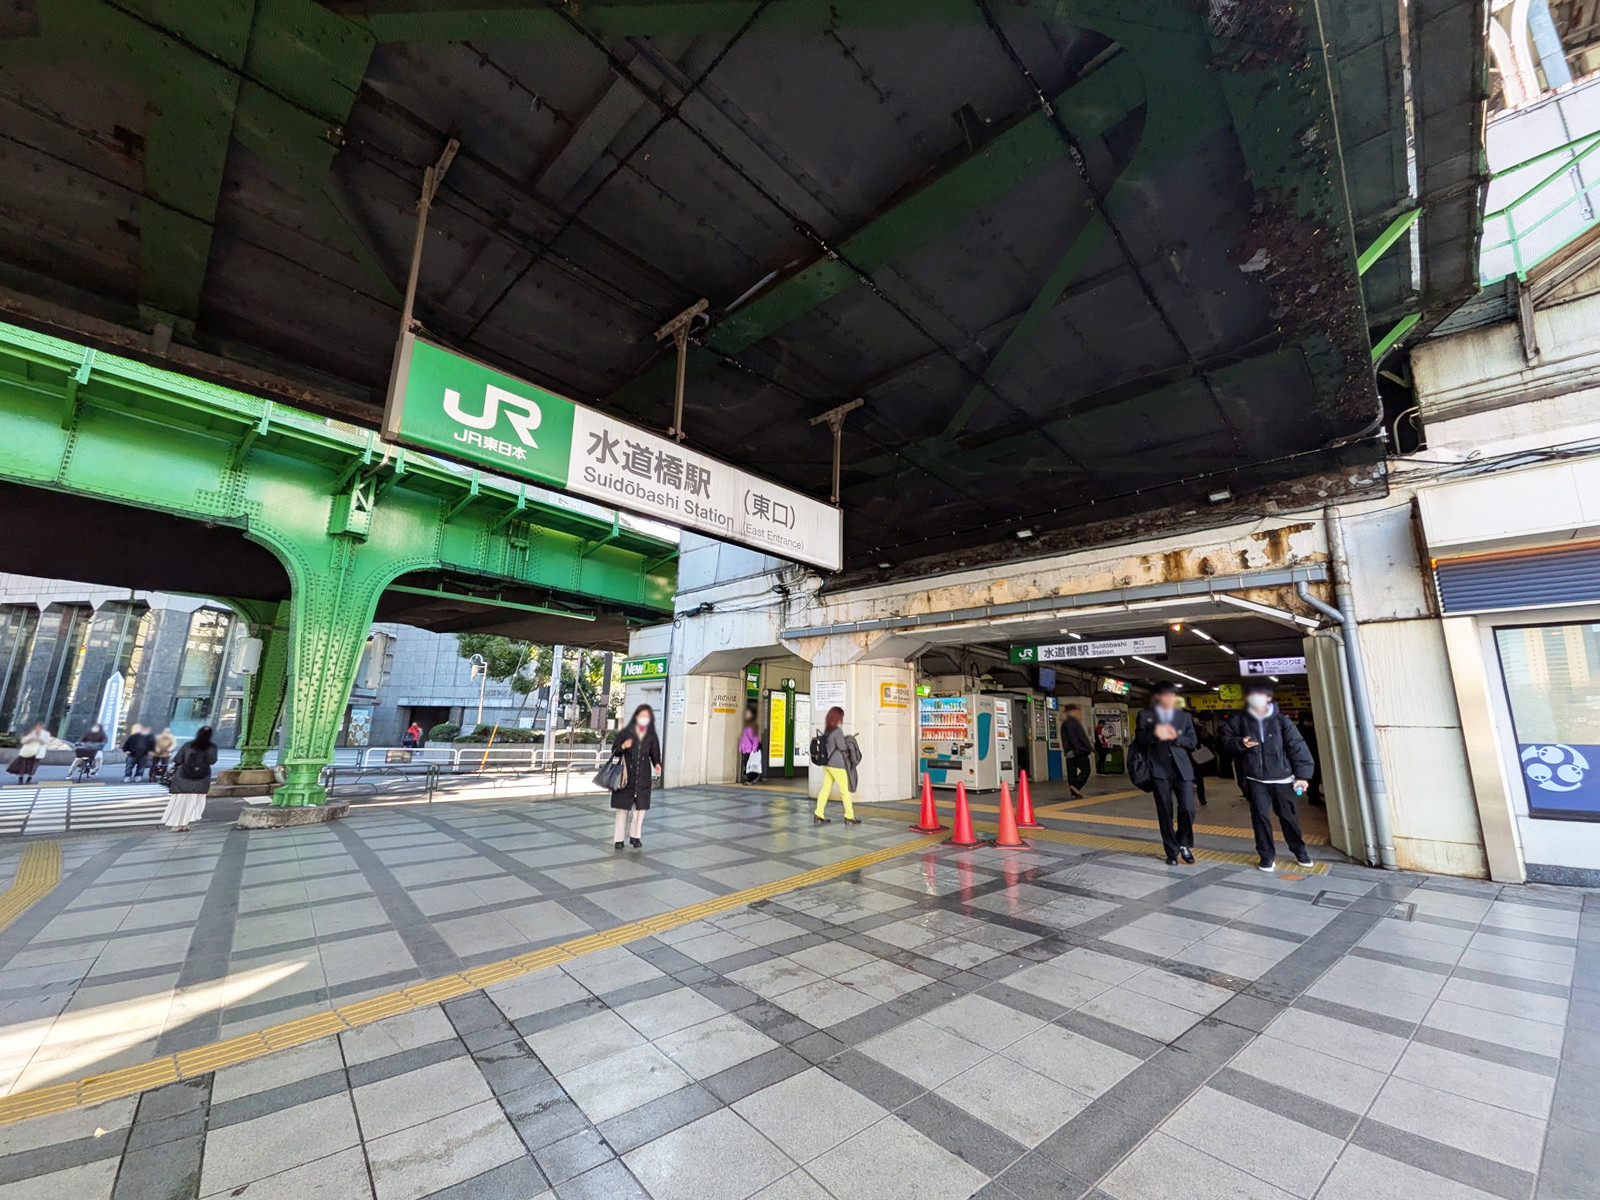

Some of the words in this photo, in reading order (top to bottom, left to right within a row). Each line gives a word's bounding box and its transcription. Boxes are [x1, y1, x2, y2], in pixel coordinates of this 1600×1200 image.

[443, 384, 542, 449] JR
[453, 429, 527, 460] JR東日本
[586, 429, 711, 499] 水道橋駅
[583, 466, 679, 510] Suidōbashi
[684, 499, 734, 530] Station
[742, 521, 765, 534] (East
[767, 530, 804, 551] Entrance)
[1018, 648, 1033, 658] JR
[1043, 644, 1090, 659] 水道橋駅
[1264, 659, 1301, 667] きっぷうりば
[624, 661, 664, 676] NewDays
